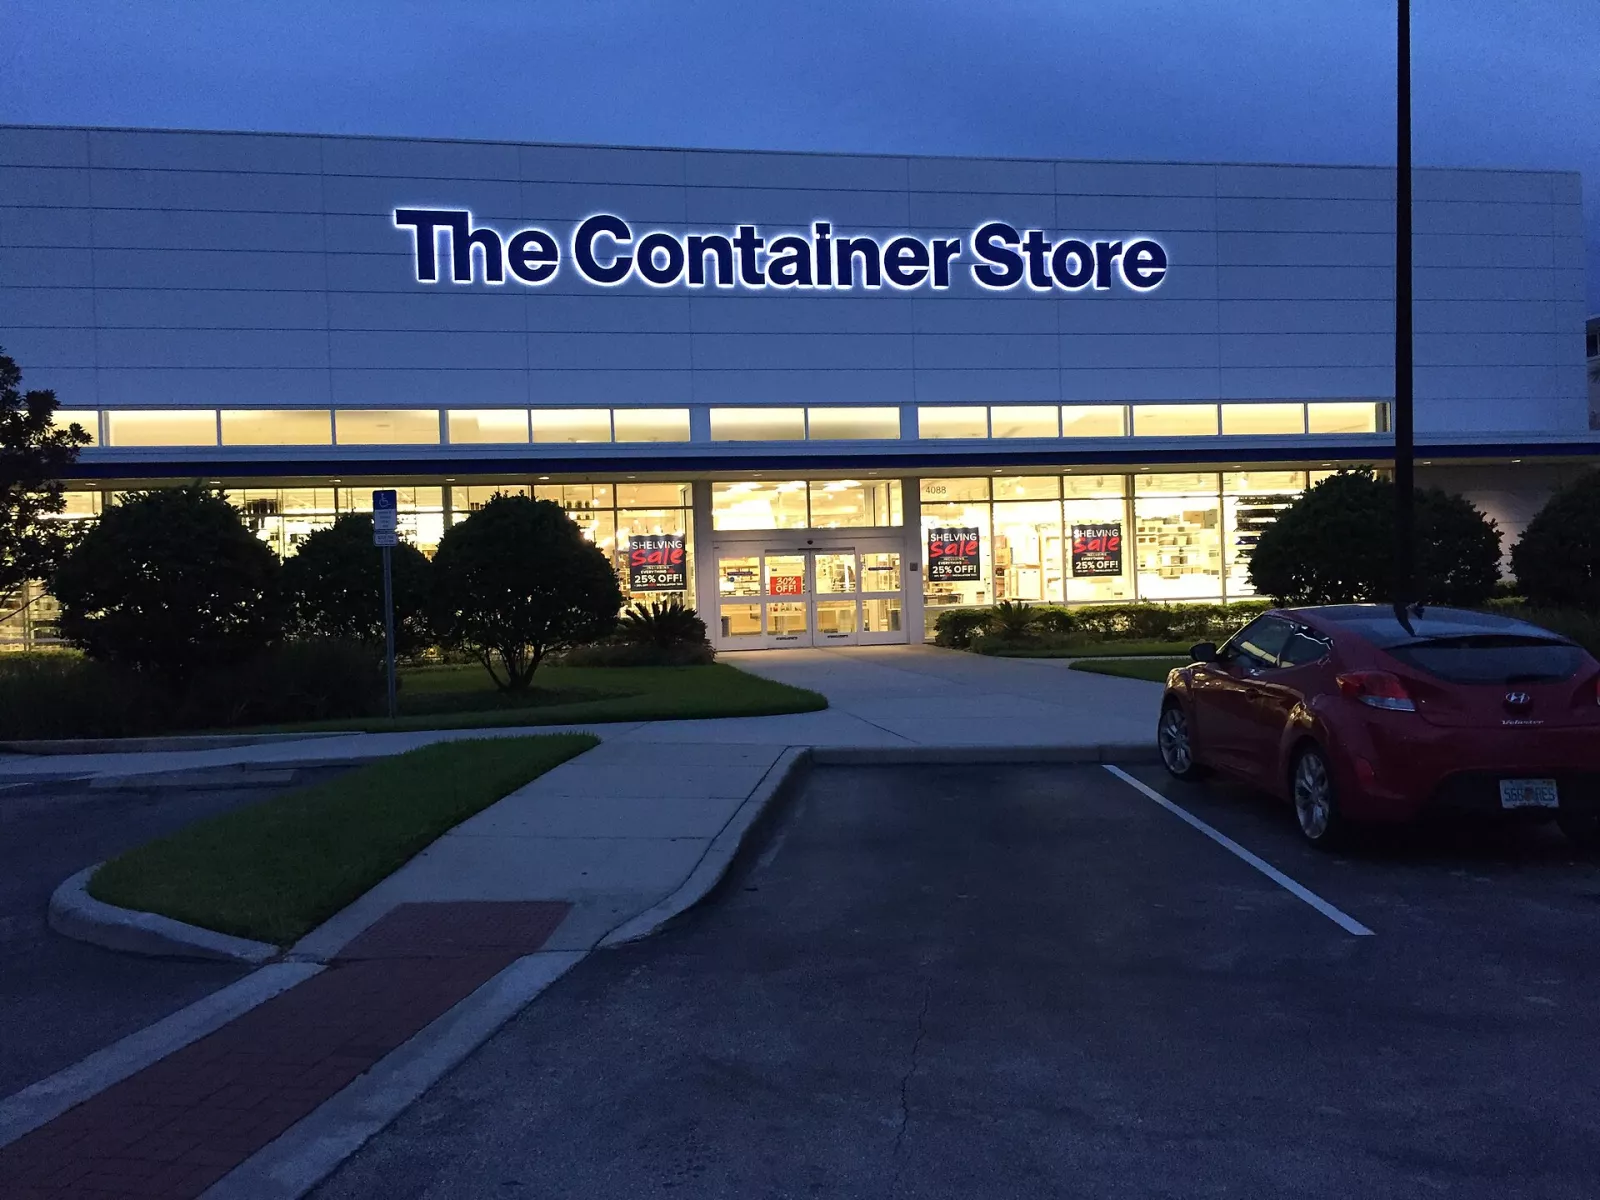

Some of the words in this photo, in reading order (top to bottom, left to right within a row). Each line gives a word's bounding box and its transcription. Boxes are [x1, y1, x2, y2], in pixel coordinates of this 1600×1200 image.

[396, 208, 559, 284] The
[574, 213, 961, 292] Container
[972, 220, 1168, 292] Store
[925, 486, 947, 495] 4088
[930, 533, 977, 542] SHELVING
[1073, 528, 1119, 538] SHELVING
[632, 540, 683, 550] SHELVING
[953, 565, 977, 574] OFF!
[1075, 561, 1096, 570] 25%
[1096, 560, 1119, 569] OFF!
[634, 575, 656, 584] 25%
[657, 573, 683, 583] OFF!
[776, 576, 796, 585] 30%
[775, 585, 797, 593] OFF!
